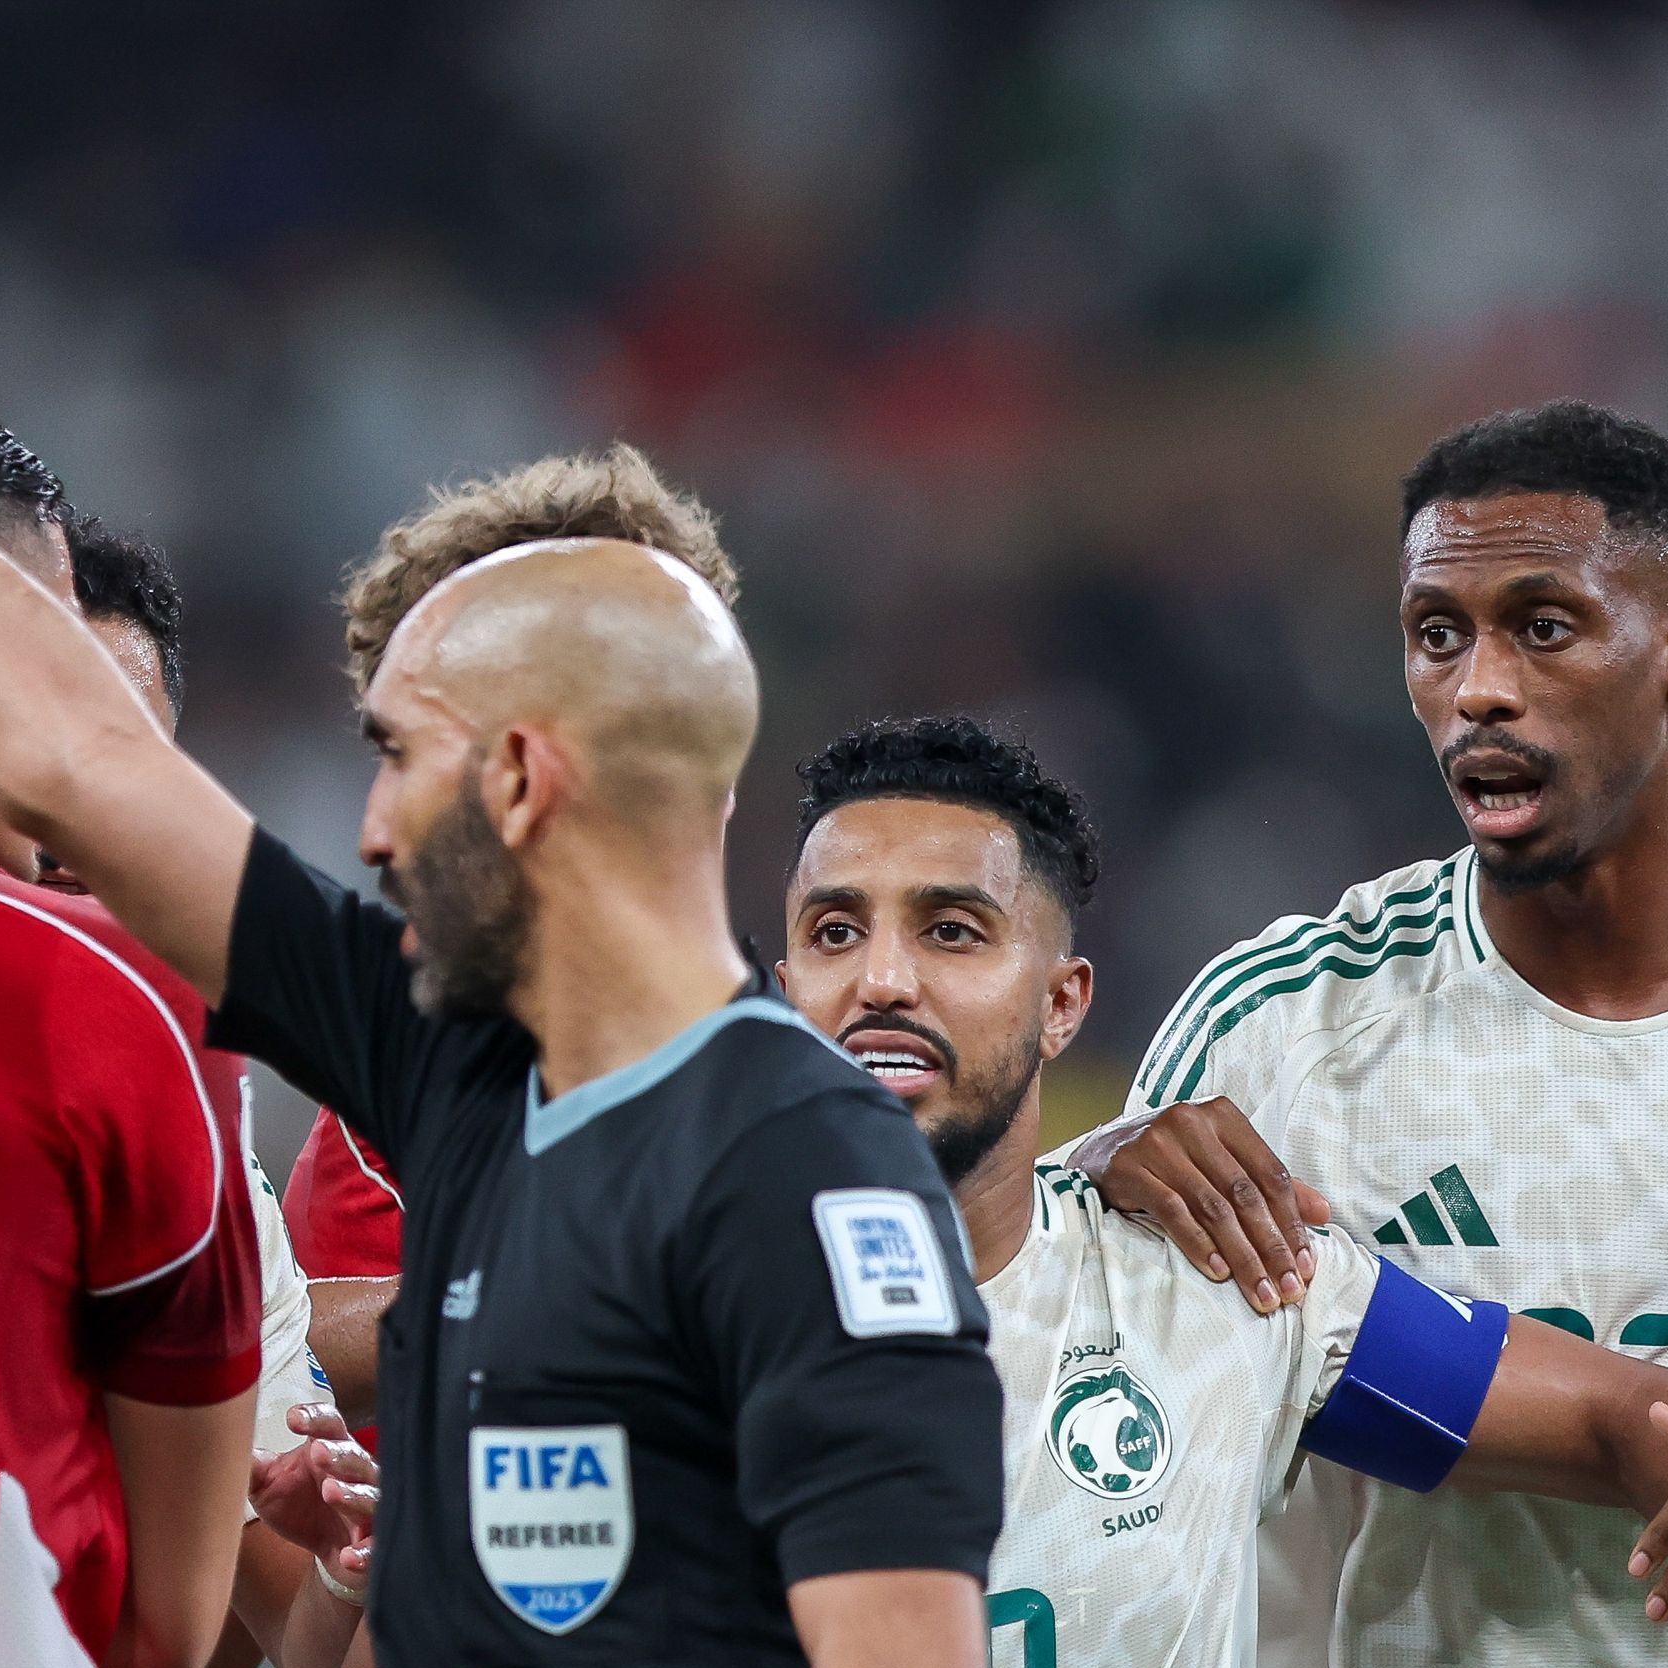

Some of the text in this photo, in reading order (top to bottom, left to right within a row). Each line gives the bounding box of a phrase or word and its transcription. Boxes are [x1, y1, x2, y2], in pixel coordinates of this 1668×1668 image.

[1118, 1436, 1152, 1456] SAFF
[484, 1445, 610, 1490] FIFA
[487, 1521, 613, 1549] REFEREE
[1101, 1501, 1164, 1538] SAUDI
